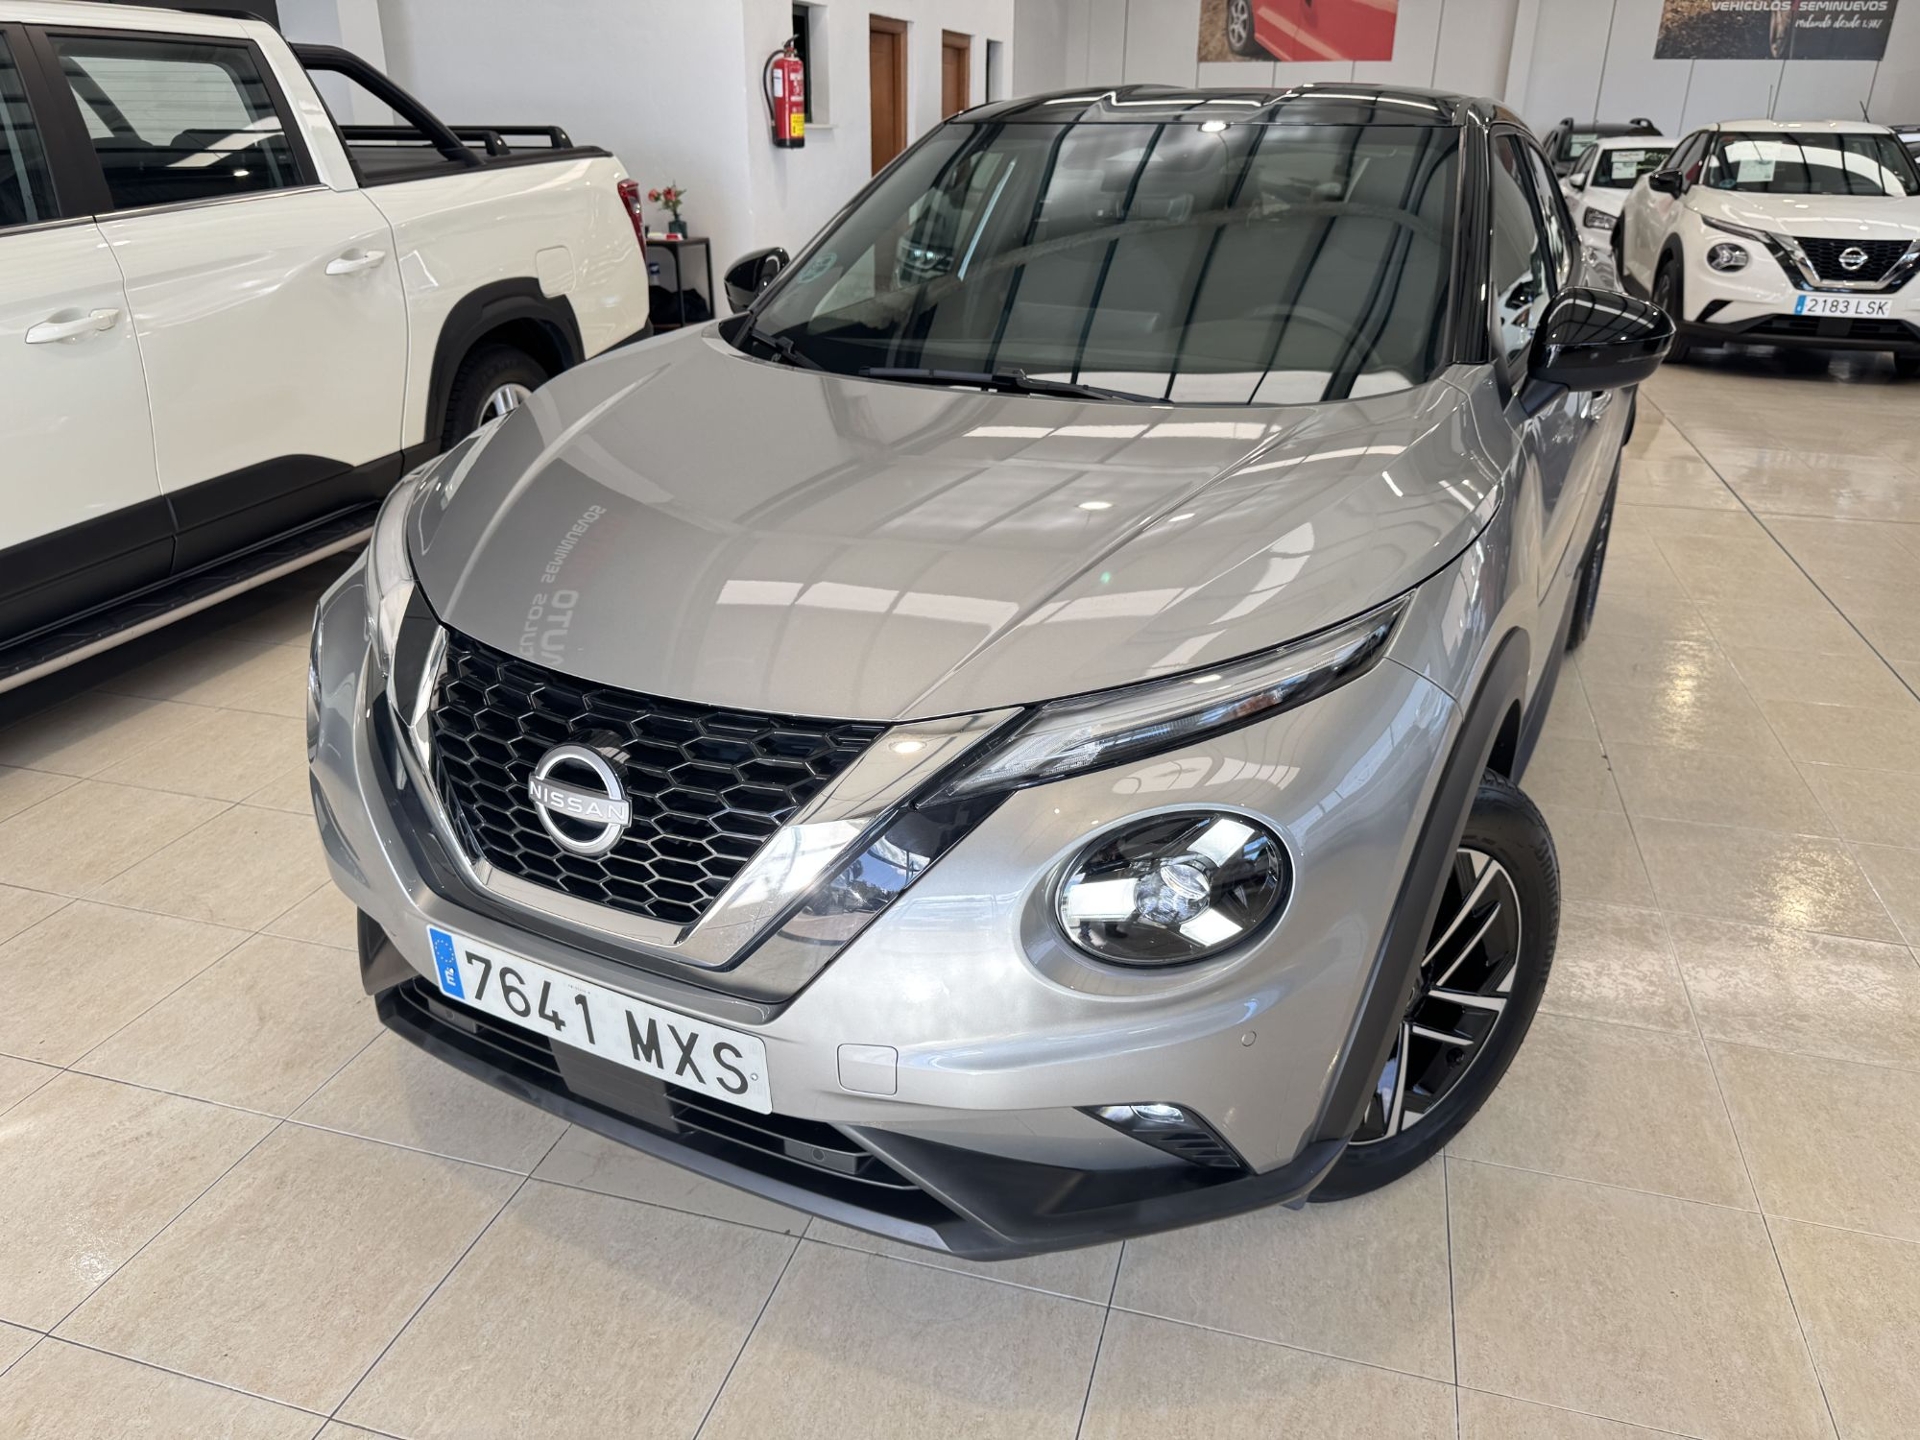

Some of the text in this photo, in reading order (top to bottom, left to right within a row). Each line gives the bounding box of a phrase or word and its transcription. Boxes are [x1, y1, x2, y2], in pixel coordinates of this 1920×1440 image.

[1798, 1, 1888, 11] SEMINUEVOS
[1833, 14, 1860, 28] desde
[1807, 299, 1888, 315] 2183 LSK
[530, 781, 625, 820] NISSAN
[466, 951, 749, 1094] 7641 MXS
